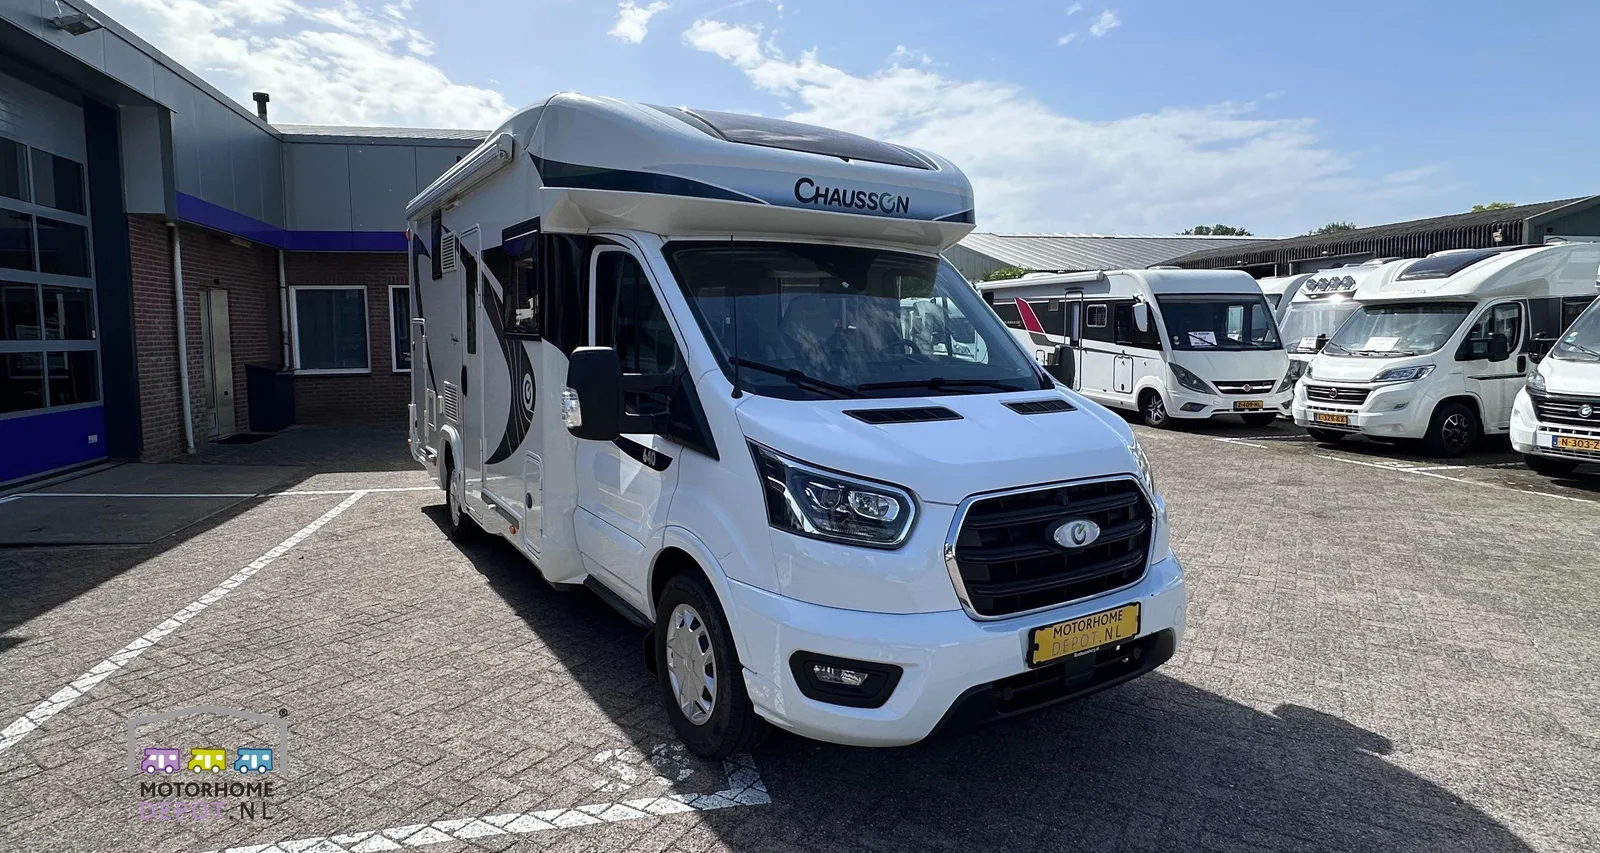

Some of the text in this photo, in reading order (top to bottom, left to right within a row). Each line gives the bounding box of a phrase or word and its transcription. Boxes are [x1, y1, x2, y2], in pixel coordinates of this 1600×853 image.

[794, 177, 910, 214] CHAUSSON
[642, 448, 656, 466] 640
[1053, 610, 1123, 639] MOTORHOME
